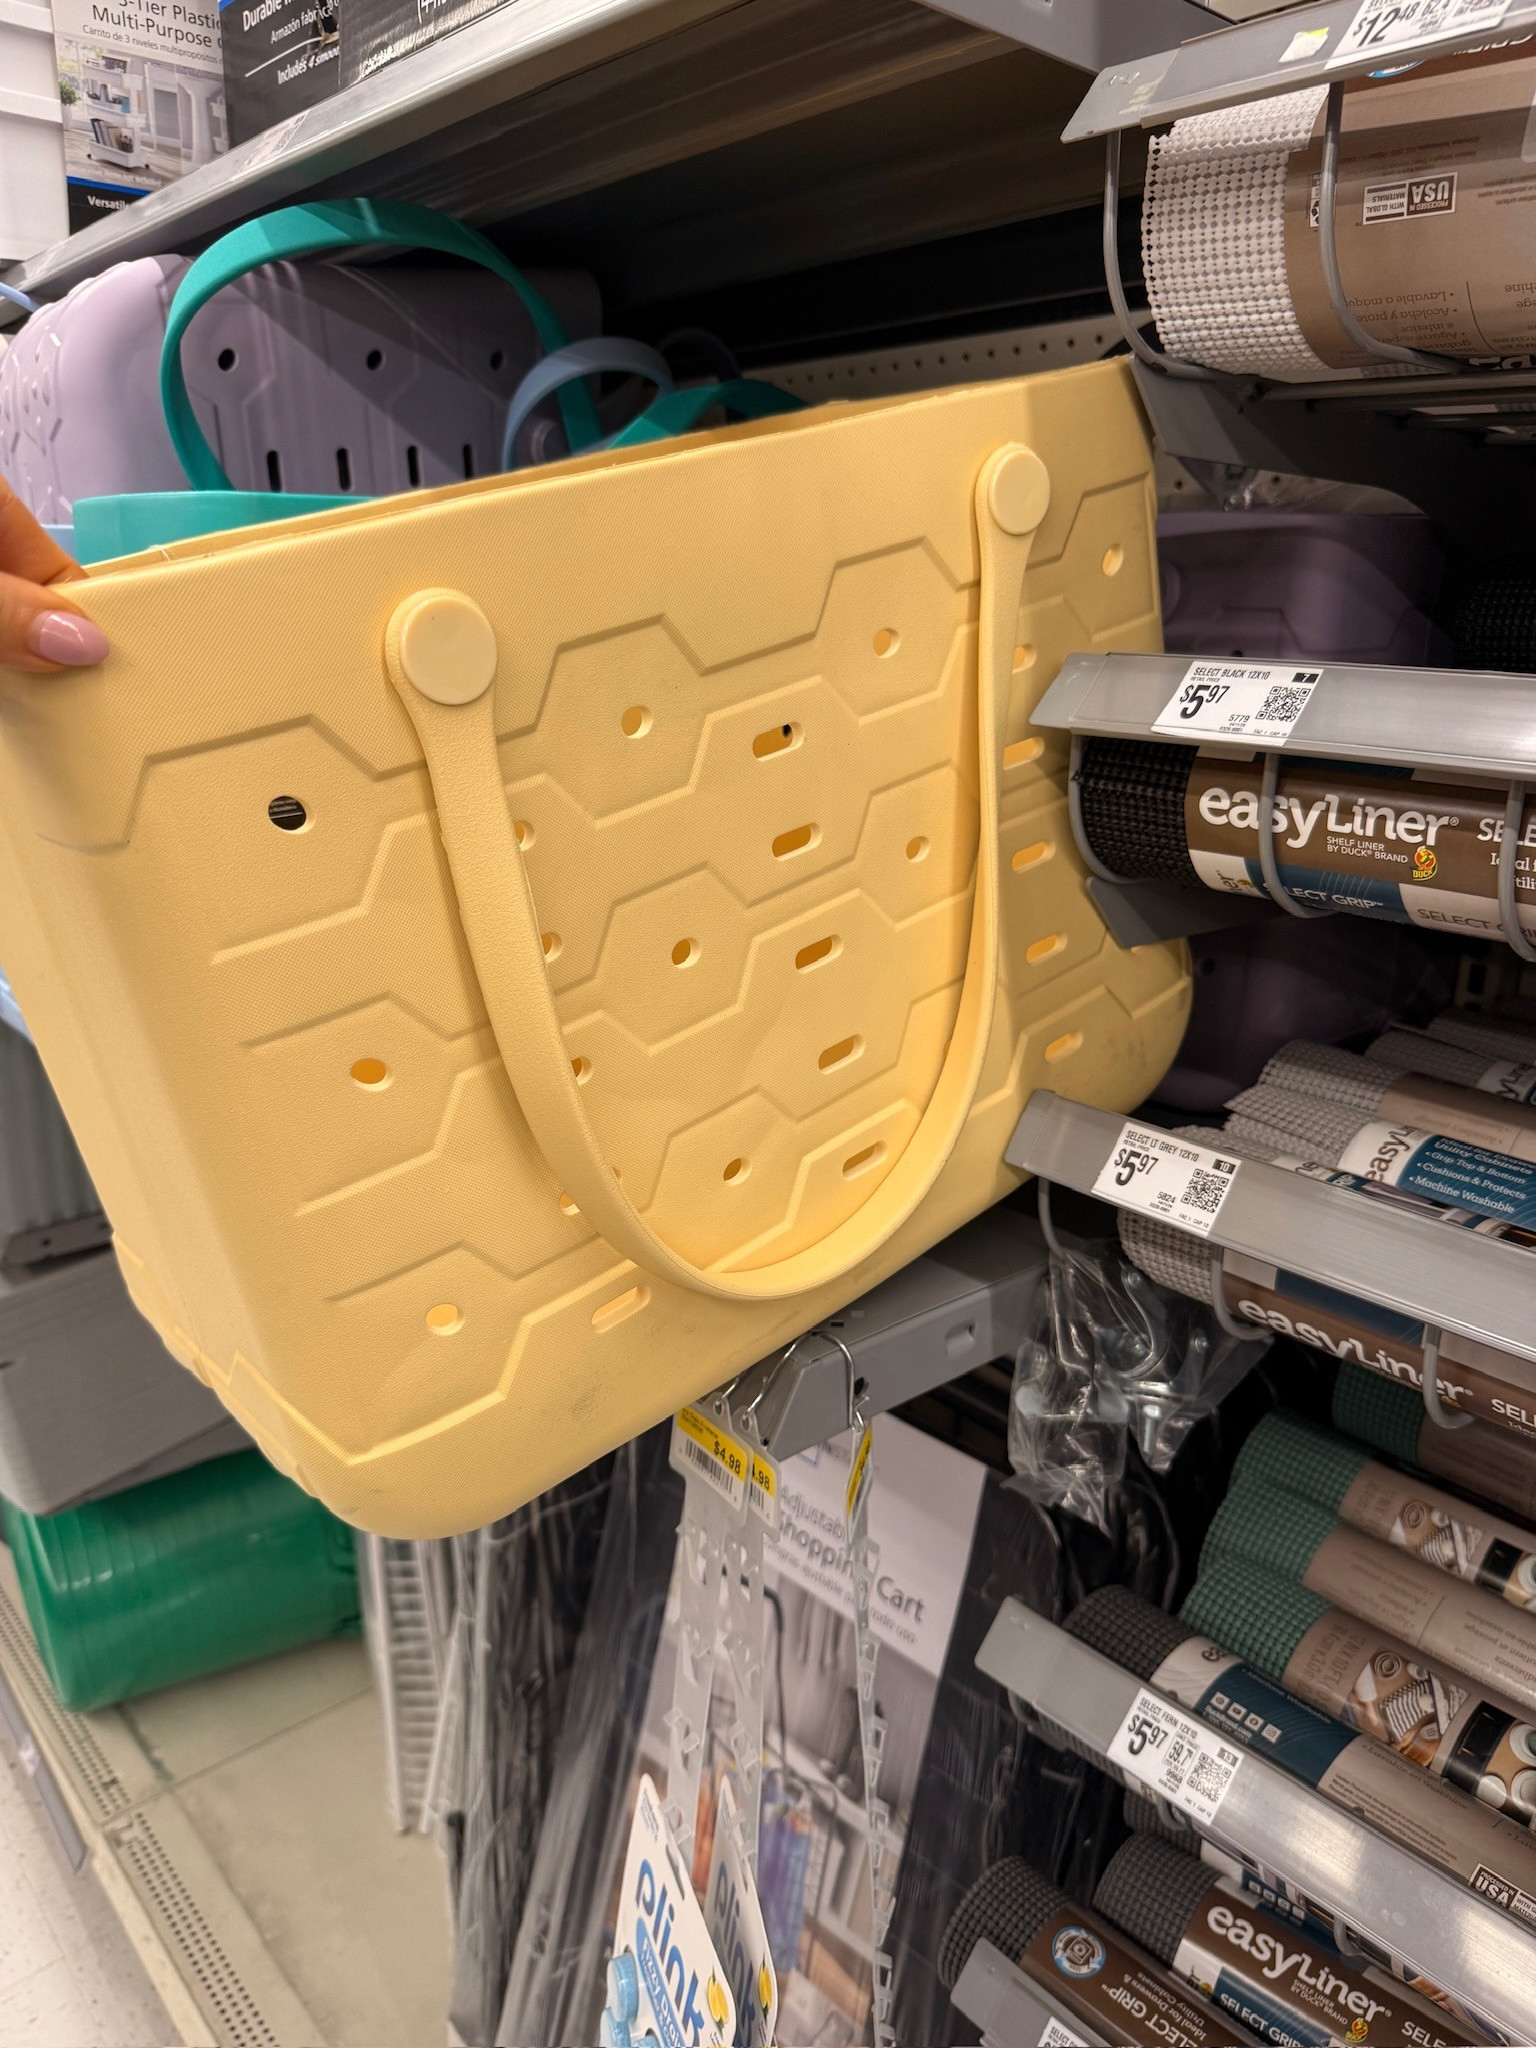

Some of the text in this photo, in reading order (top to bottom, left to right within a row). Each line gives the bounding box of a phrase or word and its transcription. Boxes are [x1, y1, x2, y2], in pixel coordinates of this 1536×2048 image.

[93, 4, 212, 48] Multi-Purpose
[113, 32, 123, 42] de
[125, 34, 131, 43] 3
[132, 37, 158, 50] niveles
[277, 54, 308, 84] Includes
[1372, 192, 1406, 203] MATERIALS
[1411, 181, 1449, 204] USA
[1366, 202, 1405, 213] WITH GLOBAL
[1416, 200, 1449, 210] PROCESSED
[1396, 291, 1447, 306] Lavable
[1193, 667, 1271, 680] SELECT BLACK 12X10
[1228, 714, 1250, 723] 5779
[1327, 836, 1384, 852] SHELF LINER
[1327, 845, 1338, 853] BY
[1375, 852, 1408, 864] BRAND
[1412, 868, 1434, 879] DUCK
[1418, 908, 1491, 930] SELECT
[1125, 1130, 1200, 1162] SELECT LT GREY 12X10
[1431, 1151, 1456, 1167] Grip
[1456, 1159, 1477, 1173] Top
[1487, 1166, 1526, 1185] Bottom
[1474, 1152, 1534, 1175] Cabinets
[1422, 1162, 1473, 1184] Cushions
[1481, 1178, 1527, 1201] Protects
[1157, 1191, 1177, 1204] 5824
[1413, 1175, 1515, 1214] Machine Washable
[714, 1442, 741, 1475] $4.98
[876, 1576, 926, 1625] Cart
[1139, 1697, 1162, 1715] SELECT
[1162, 1711, 1179, 1727] FERN
[1179, 1722, 1198, 1739] 12X10
[1475, 1875, 1509, 1907] USA
[636, 1858, 705, 2047] plink
[1131, 1979, 1168, 2012] Drawers
[1168, 2007, 1181, 2022] for
[1181, 2018, 1207, 2041] Ideal
[1177, 2001, 1205, 2027] Utility
[1218, 1992, 1268, 2034] SELECT
[1323, 2005, 1349, 2025] BRAND
